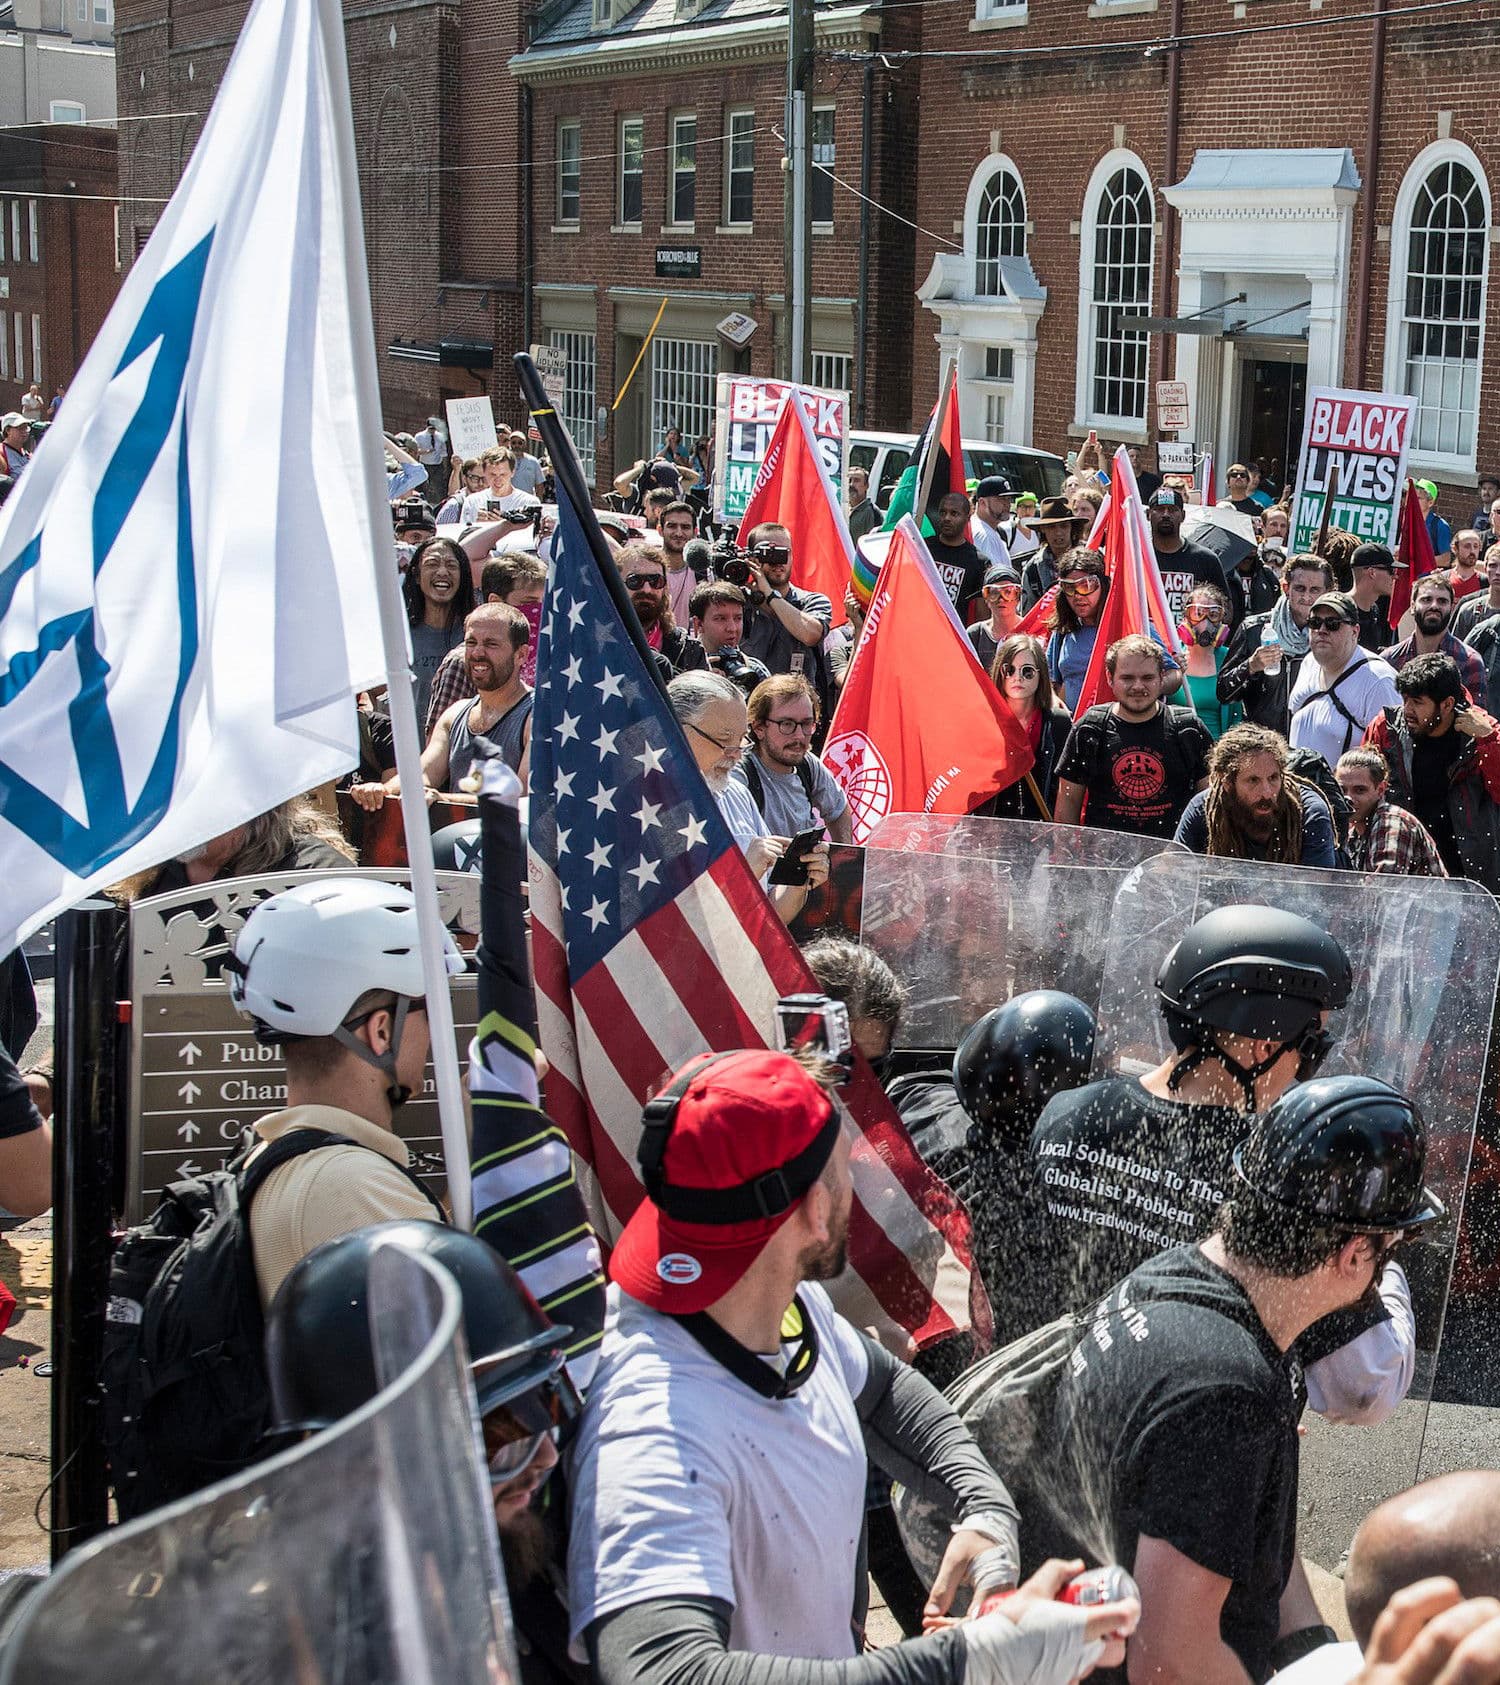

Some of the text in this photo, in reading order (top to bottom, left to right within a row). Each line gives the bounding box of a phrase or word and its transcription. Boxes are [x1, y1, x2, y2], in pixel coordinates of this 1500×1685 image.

[538, 358, 565, 368] IDLING
[547, 350, 559, 359] NO
[1312, 401, 1406, 453] BLACK
[730, 423, 840, 479] LIS
[1160, 454, 1193, 464] NO PARKING
[1305, 448, 1396, 502] LIVES
[938, 564, 963, 585] ACK
[1165, 574, 1192, 592] ACK
[221, 1043, 286, 1064] Publ
[1039, 1139, 1224, 1204] Local Solutions To The
[1044, 1166, 1195, 1227] Globalist Problem
[1047, 1200, 1187, 1250] www.tradworker.org
